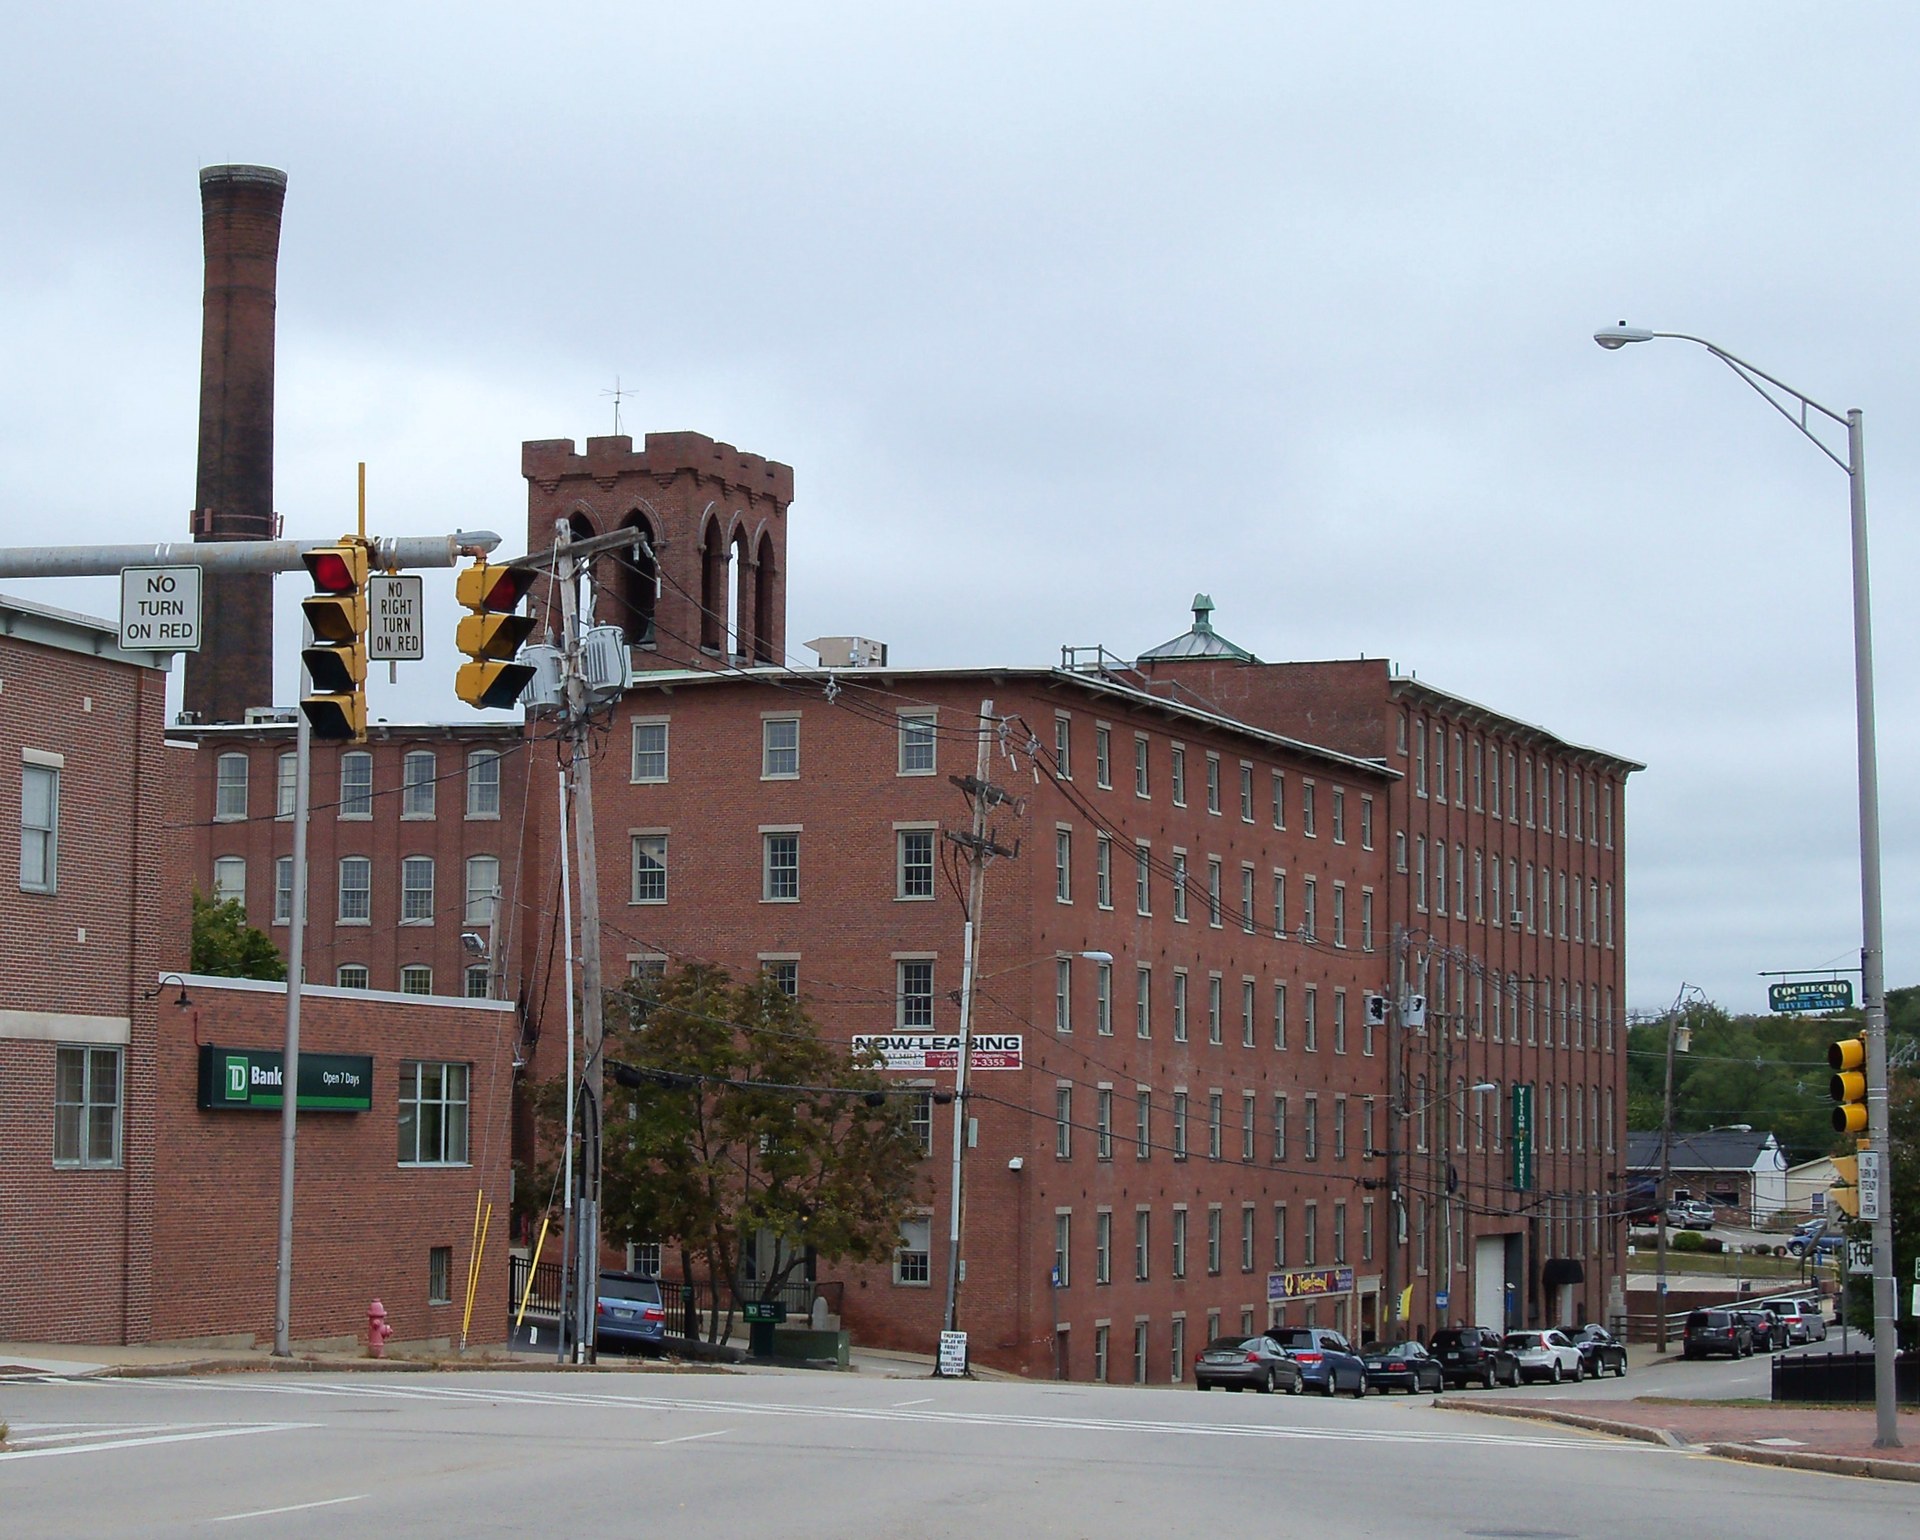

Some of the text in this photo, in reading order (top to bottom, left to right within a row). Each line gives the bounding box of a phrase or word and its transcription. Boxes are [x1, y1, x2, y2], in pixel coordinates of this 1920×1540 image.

[147, 576, 175, 593] NO
[388, 582, 402, 597] NO
[138, 600, 183, 616] TURN
[381, 600, 412, 615] RIGHT
[127, 623, 193, 639] ON RED
[383, 618, 411, 633] TURN
[377, 636, 418, 651] ON RED
[1815, 1000, 1845, 1008] WALK
[854, 1037, 914, 1050] NOW
[228, 1065, 283, 1091] TD Bank
[322, 1072, 360, 1087] Open 7 Days
